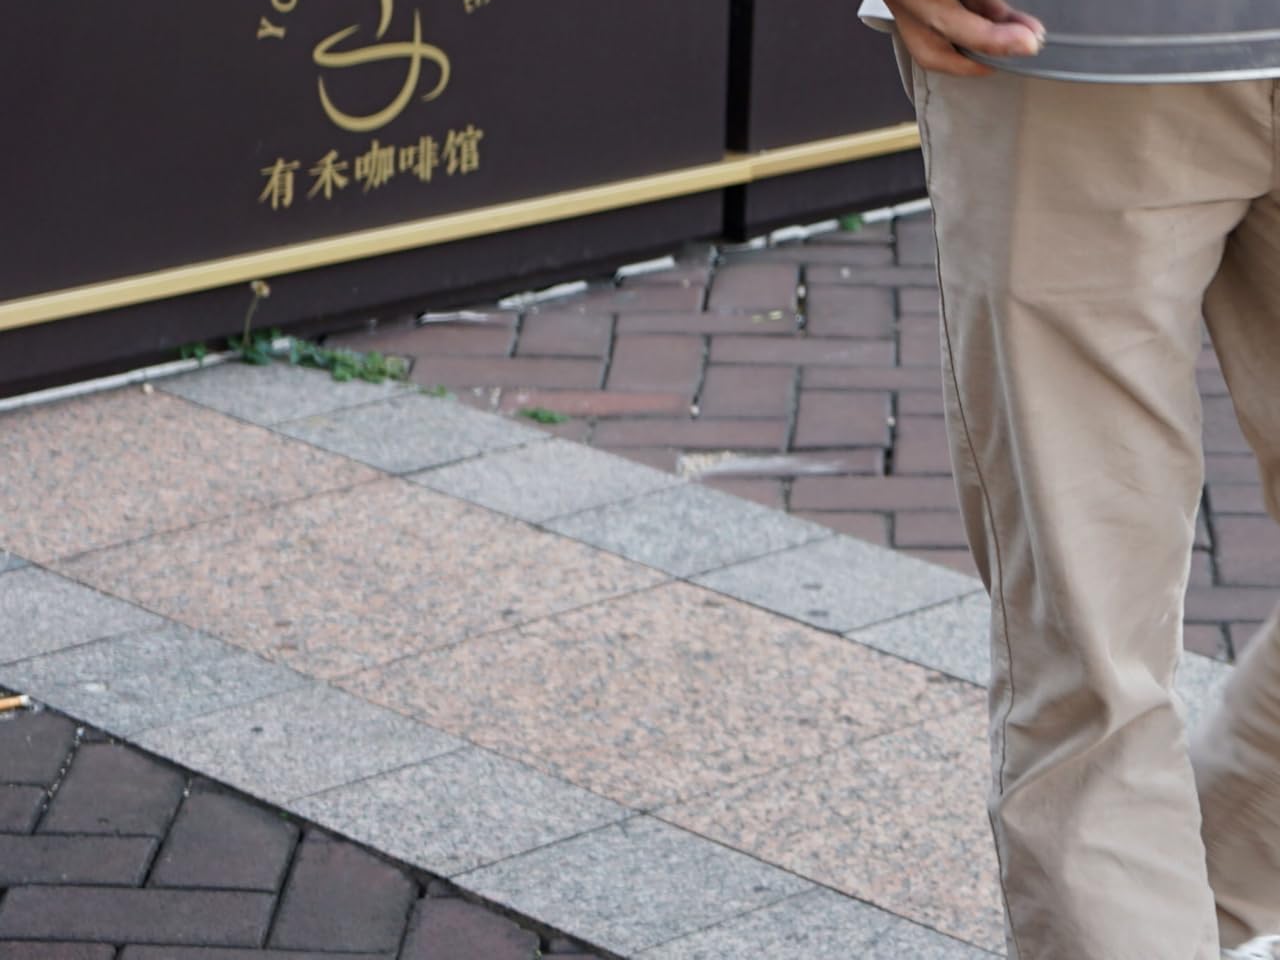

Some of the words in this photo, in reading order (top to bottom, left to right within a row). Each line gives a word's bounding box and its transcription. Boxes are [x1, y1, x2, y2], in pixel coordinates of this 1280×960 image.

[257, 124, 484, 210] 有禾咖啡馆
